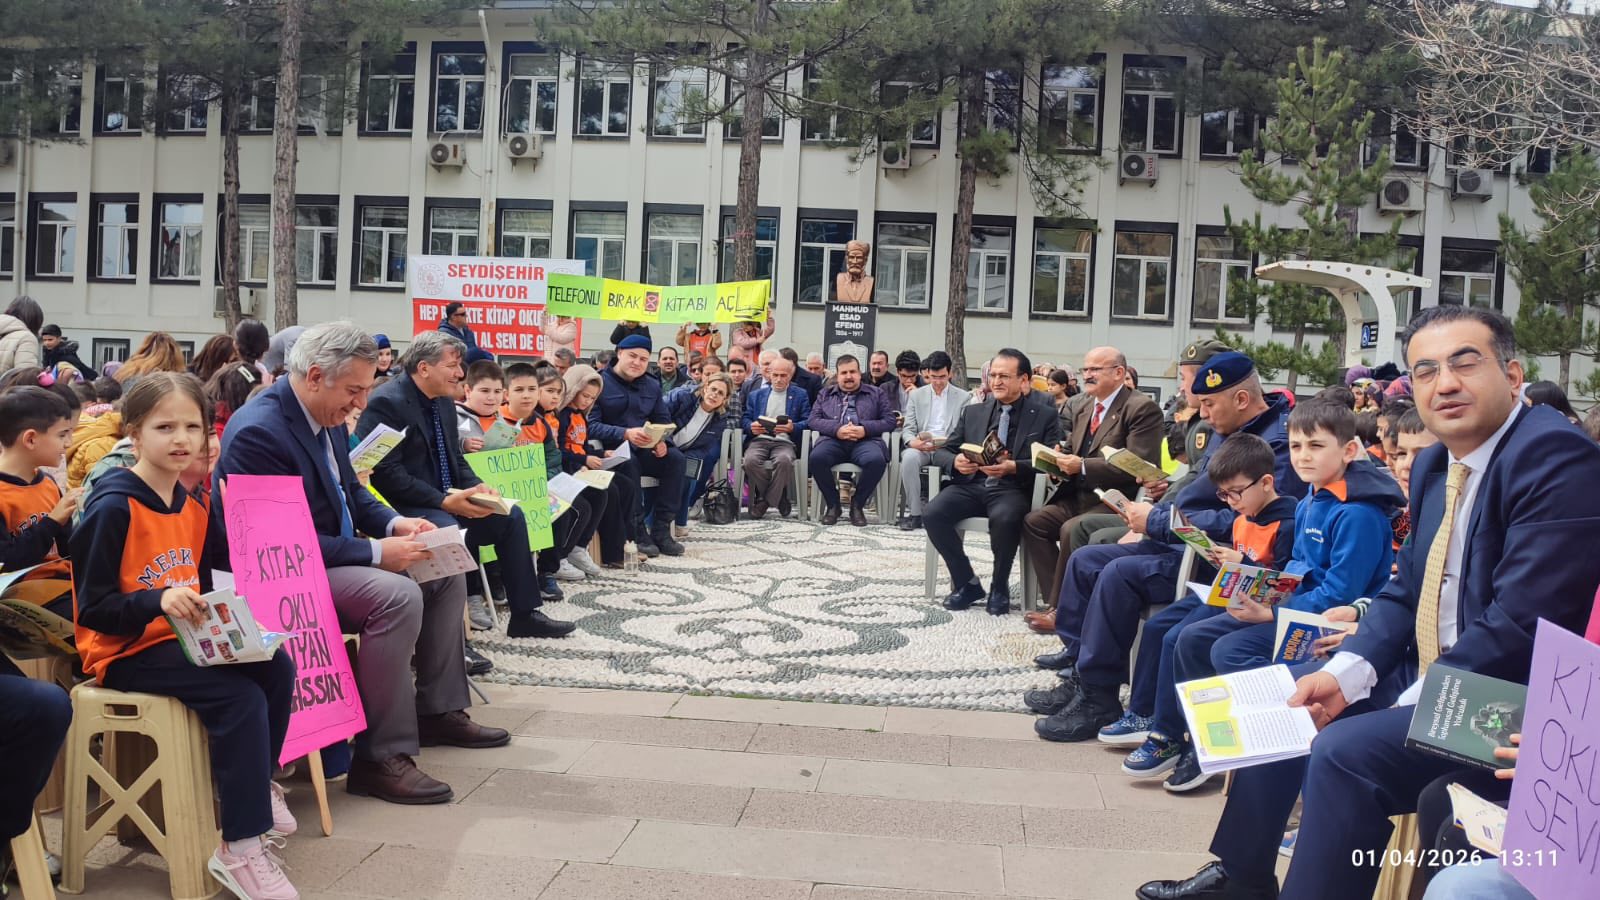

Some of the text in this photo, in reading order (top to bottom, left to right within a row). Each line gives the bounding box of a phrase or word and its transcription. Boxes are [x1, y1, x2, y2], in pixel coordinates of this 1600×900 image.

[447, 261, 544, 281] SEYDİŞEHİR
[462, 284, 528, 299] OKUYOR
[607, 292, 641, 308] BIRAK
[666, 296, 708, 312] KİTABI
[832, 304, 869, 314] MAHMUD
[420, 304, 438, 320] HEP
[486, 304, 515, 326] KİTAP
[840, 313, 860, 321] ESAD
[480, 334, 493, 348] AL
[496, 334, 516, 350] SEN
[520, 334, 534, 350] DE
[256, 542, 304, 584] KİTAP
[278, 591, 318, 632] OKU
[1550, 655, 1600, 720] Kİ
